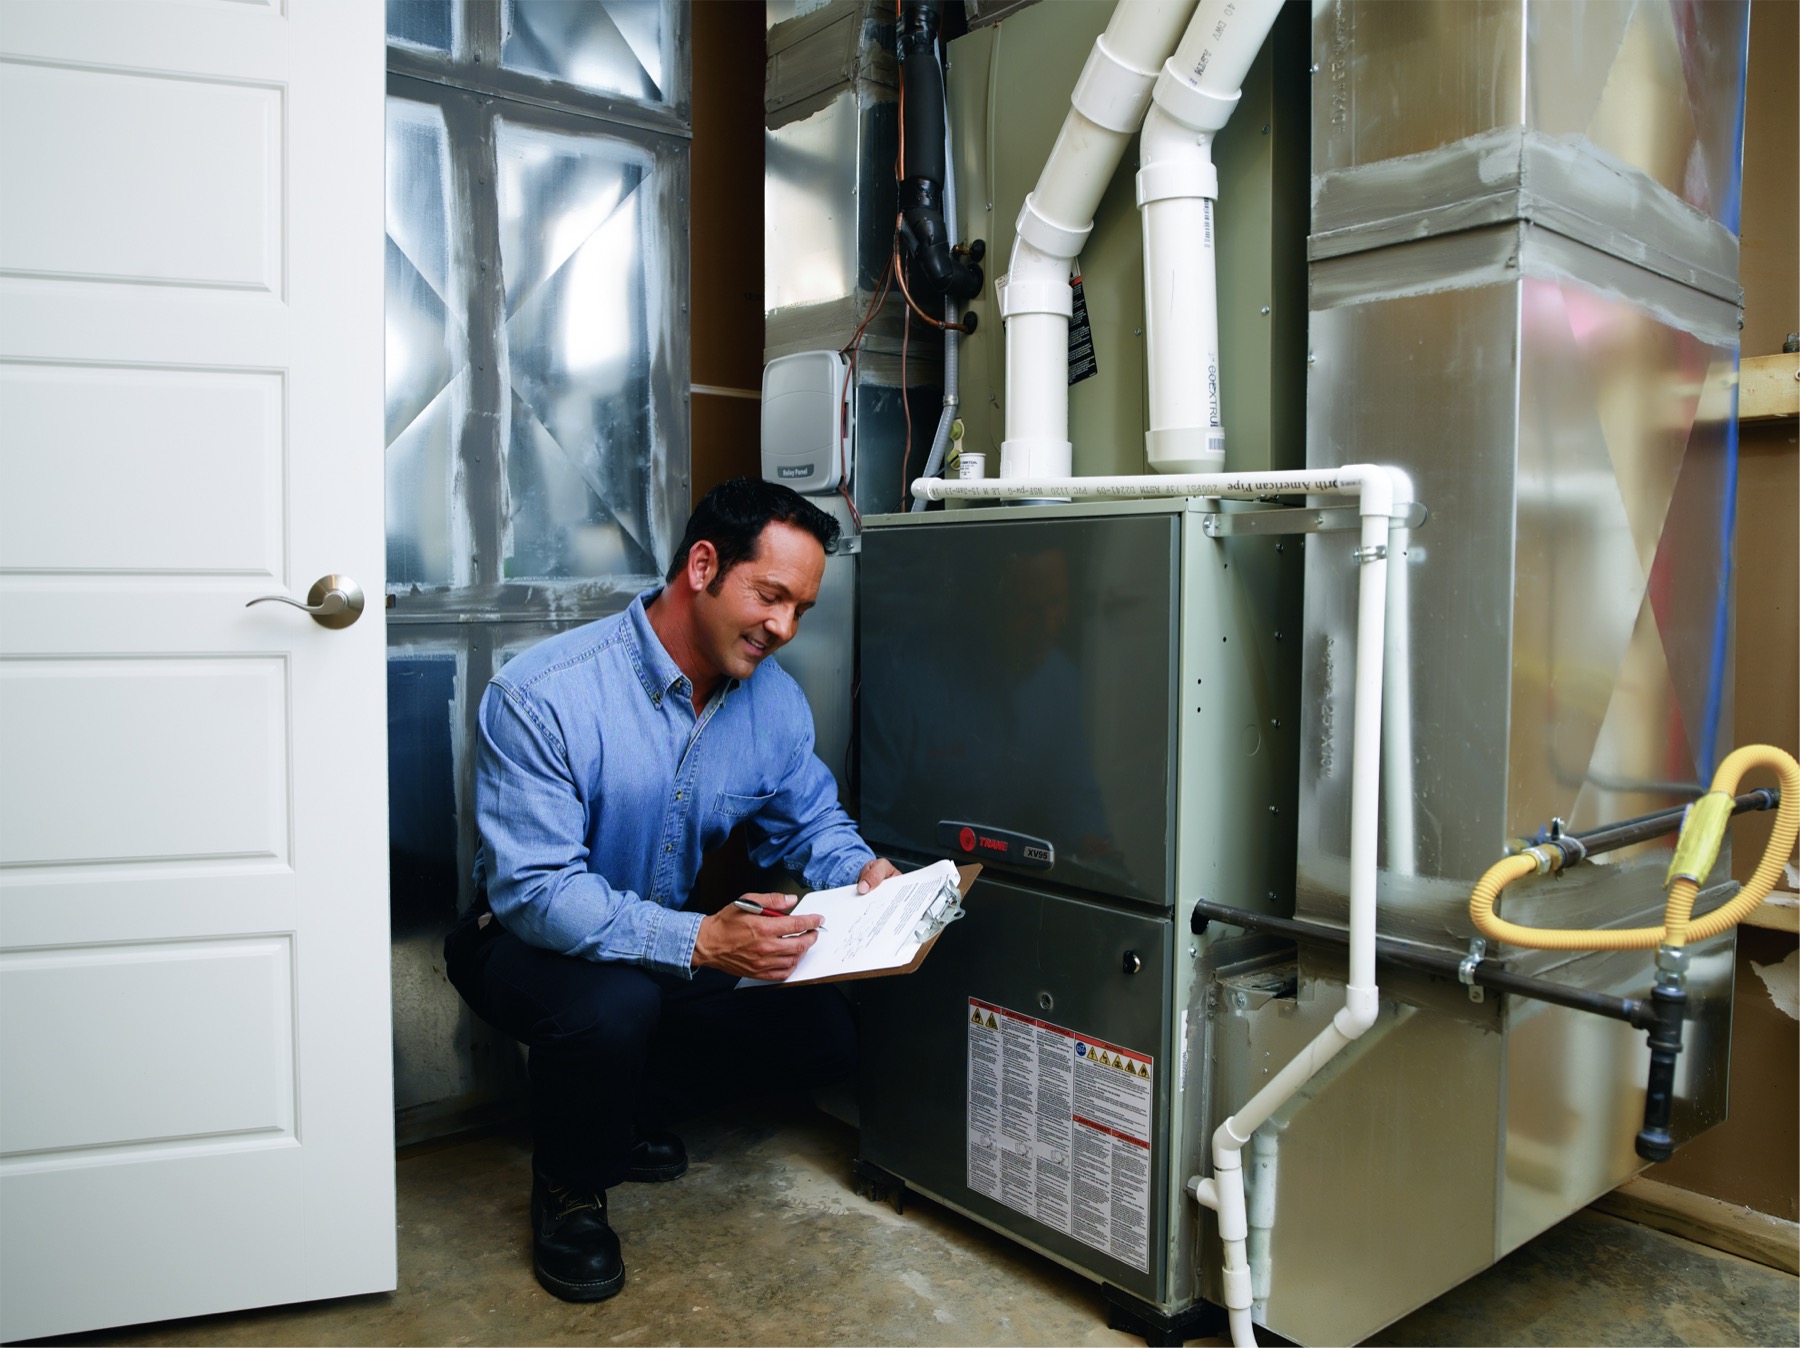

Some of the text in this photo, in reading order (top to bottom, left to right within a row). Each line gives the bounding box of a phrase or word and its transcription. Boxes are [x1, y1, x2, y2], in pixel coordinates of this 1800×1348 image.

[783, 467, 807, 477] Relay Panel
[1072, 486, 1089, 495] PVC
[1139, 485, 1160, 494] ASTM
[1186, 484, 1219, 493] 200PSI
[1227, 480, 1252, 492] Pipe
[1255, 481, 1310, 491] American
[1050, 487, 1070, 496] 1120
[979, 837, 1048, 860] TRANE XV95
